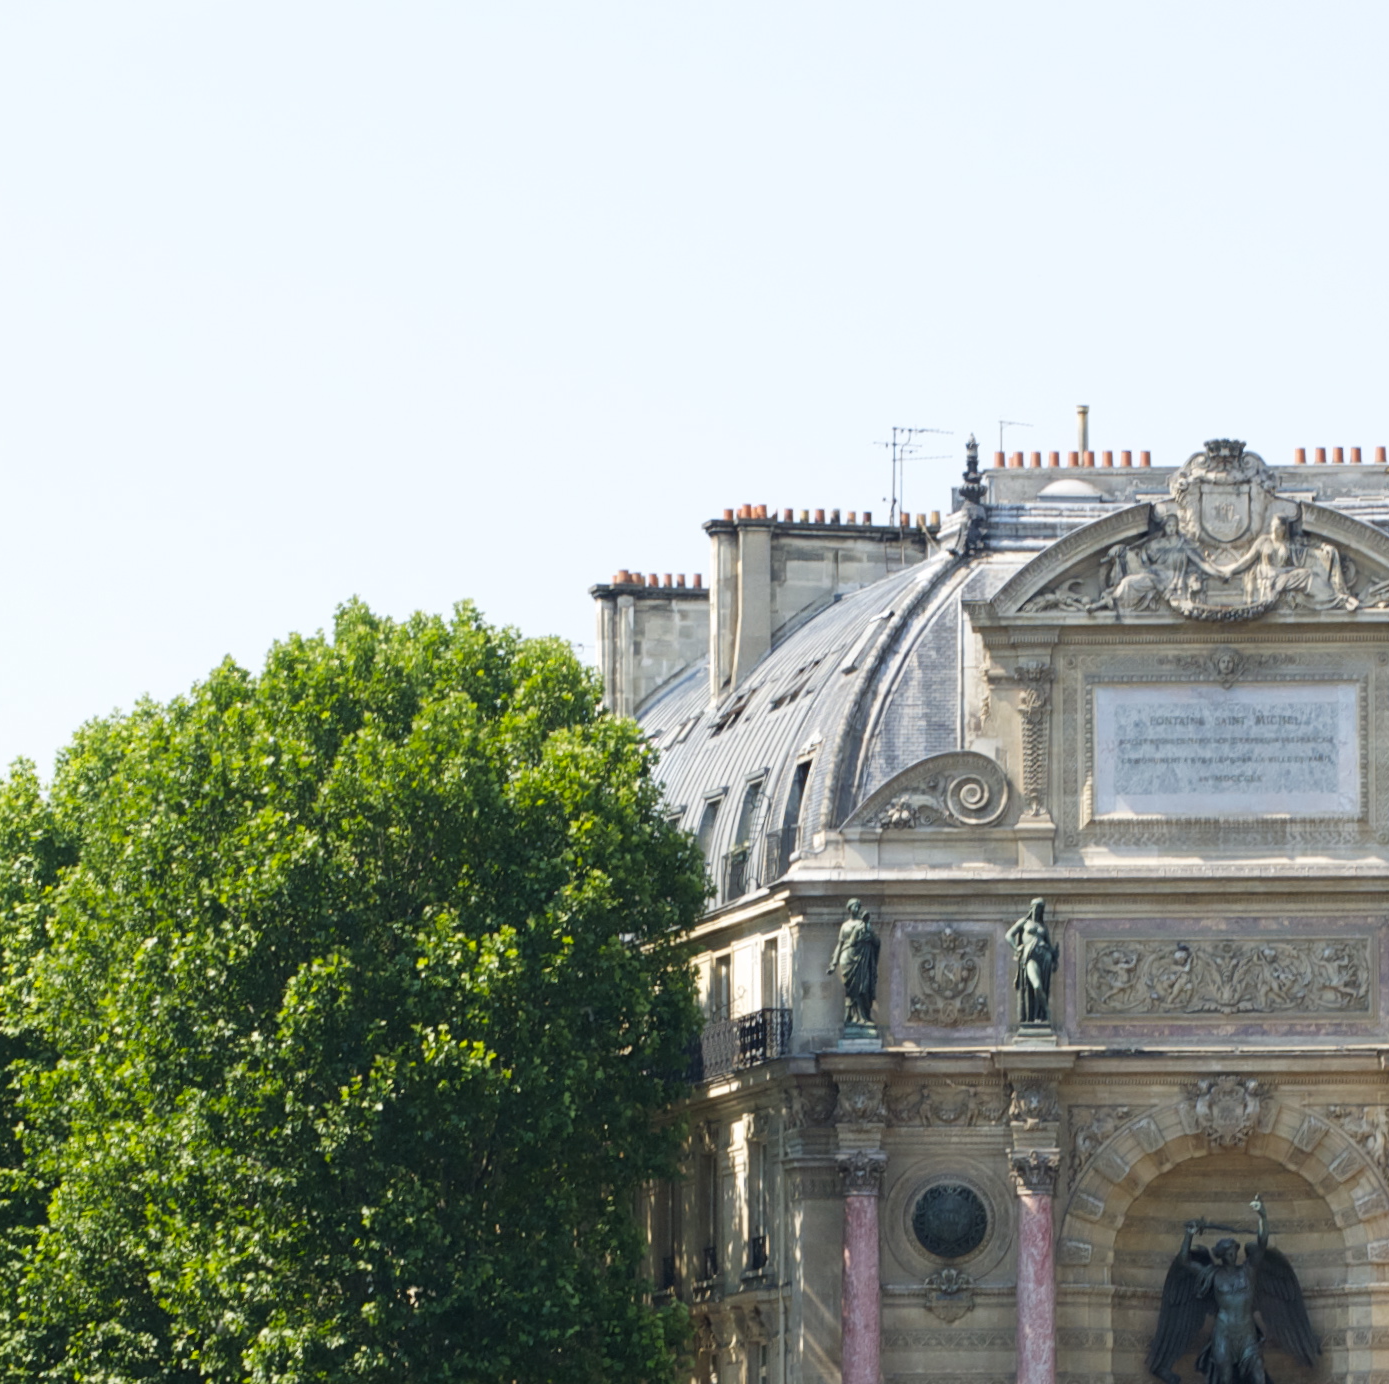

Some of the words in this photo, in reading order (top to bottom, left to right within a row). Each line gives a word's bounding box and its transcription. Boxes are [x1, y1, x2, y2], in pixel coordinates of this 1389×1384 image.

[1150, 715, 1205, 726] FONTAINE
[1214, 715, 1247, 726] SAINT
[1254, 714, 1302, 726] MICHEL
